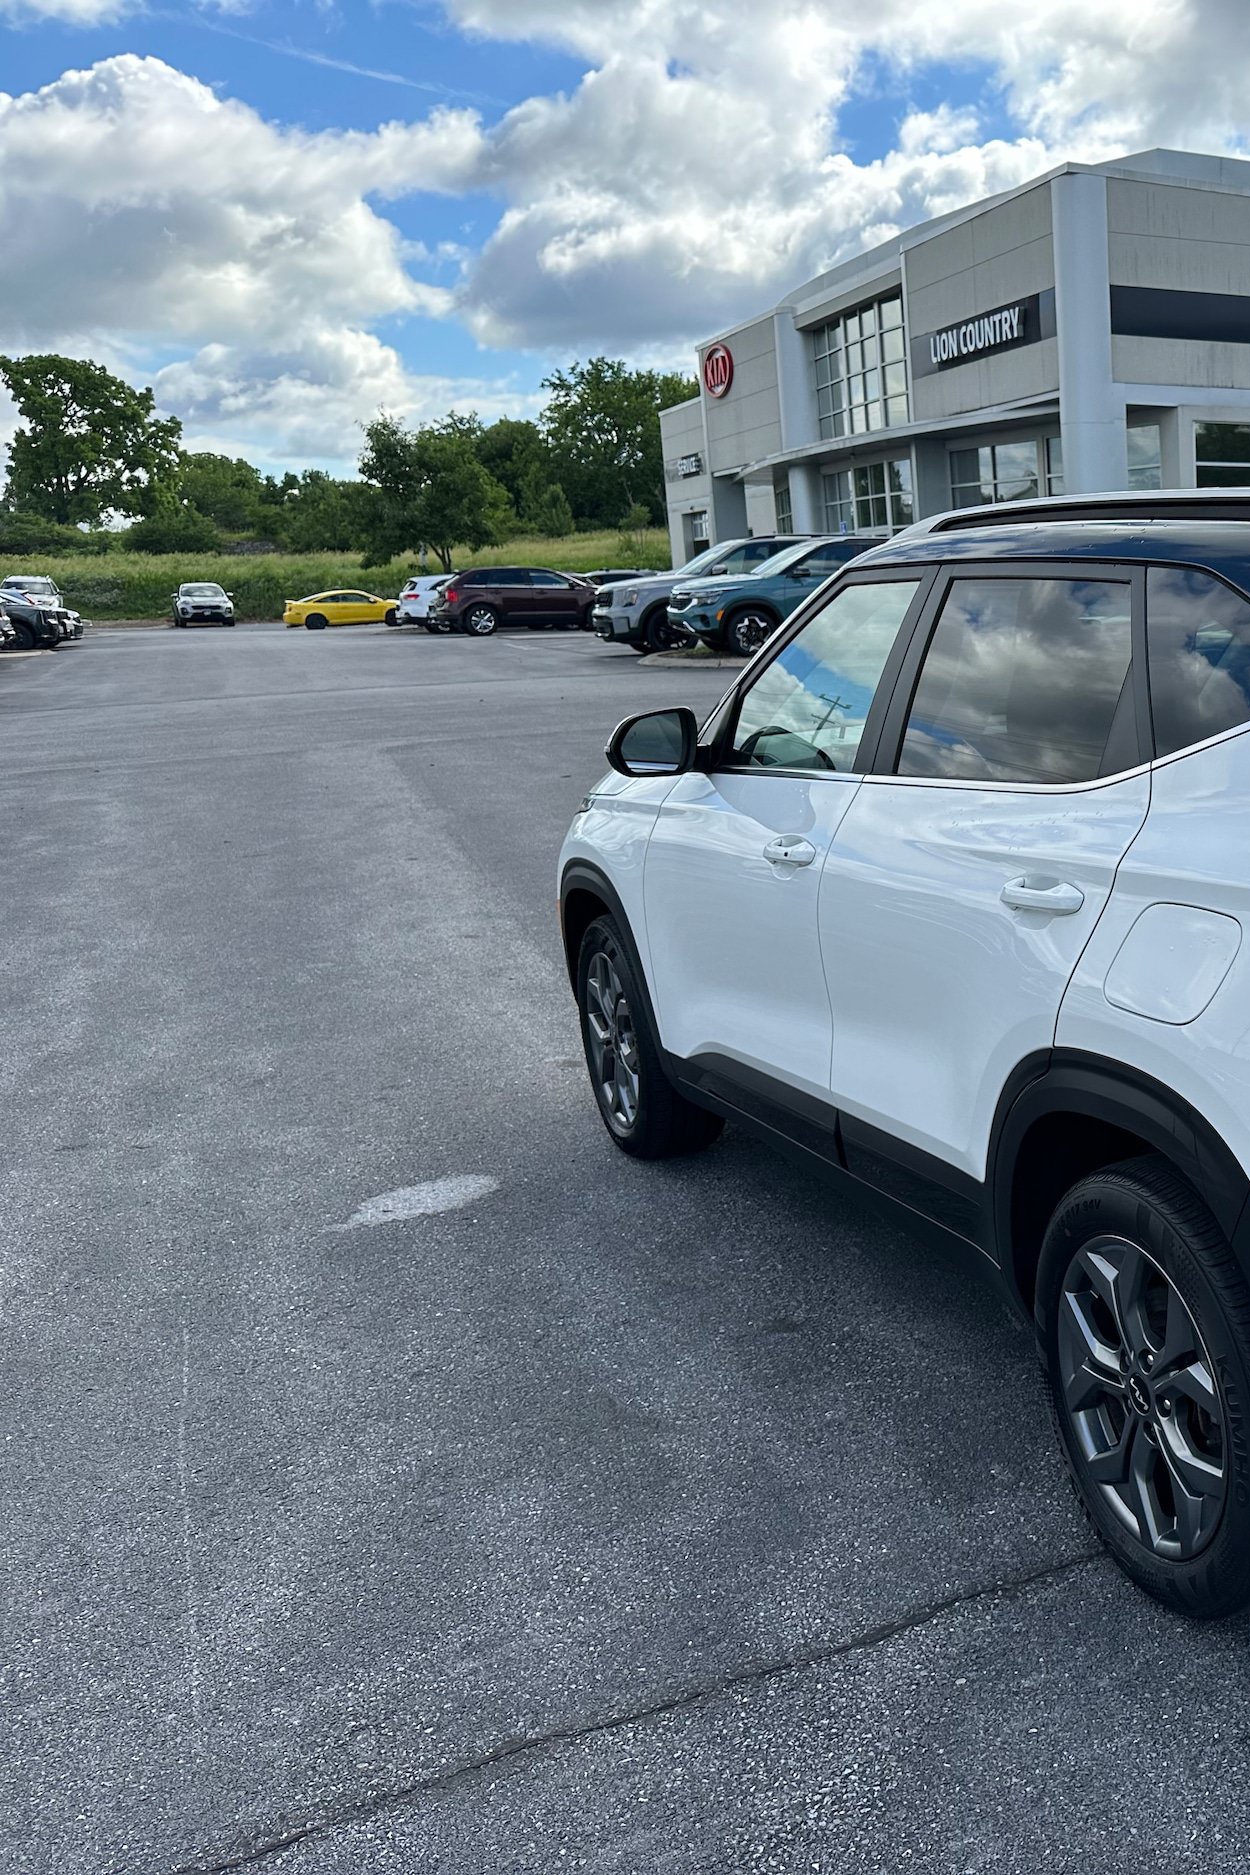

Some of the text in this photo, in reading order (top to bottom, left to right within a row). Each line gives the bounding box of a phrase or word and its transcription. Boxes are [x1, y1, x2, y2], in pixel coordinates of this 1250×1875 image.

[930, 306, 1020, 364] LION COUNTRY
[1216, 1354, 1249, 1501] KUMHO
